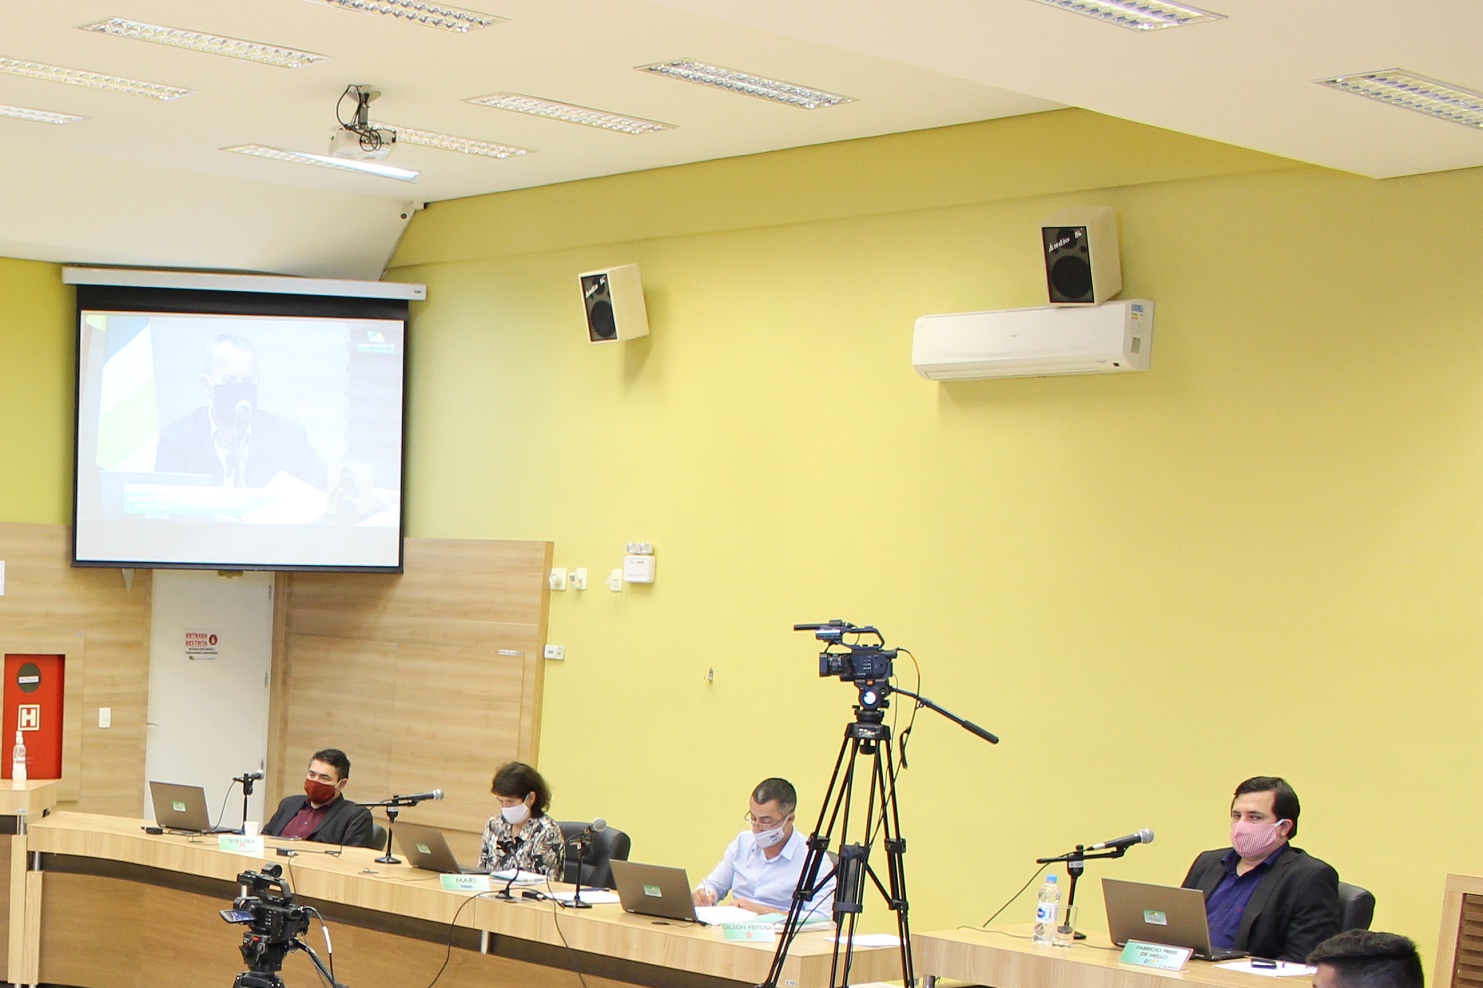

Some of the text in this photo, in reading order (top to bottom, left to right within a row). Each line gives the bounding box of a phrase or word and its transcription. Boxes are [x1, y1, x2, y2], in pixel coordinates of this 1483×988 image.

[21, 709, 37, 727] H
[228, 837, 256, 845] BIRUBA
[748, 923, 773, 931] FEITOSA
[1136, 945, 1162, 953] FABRICIO
